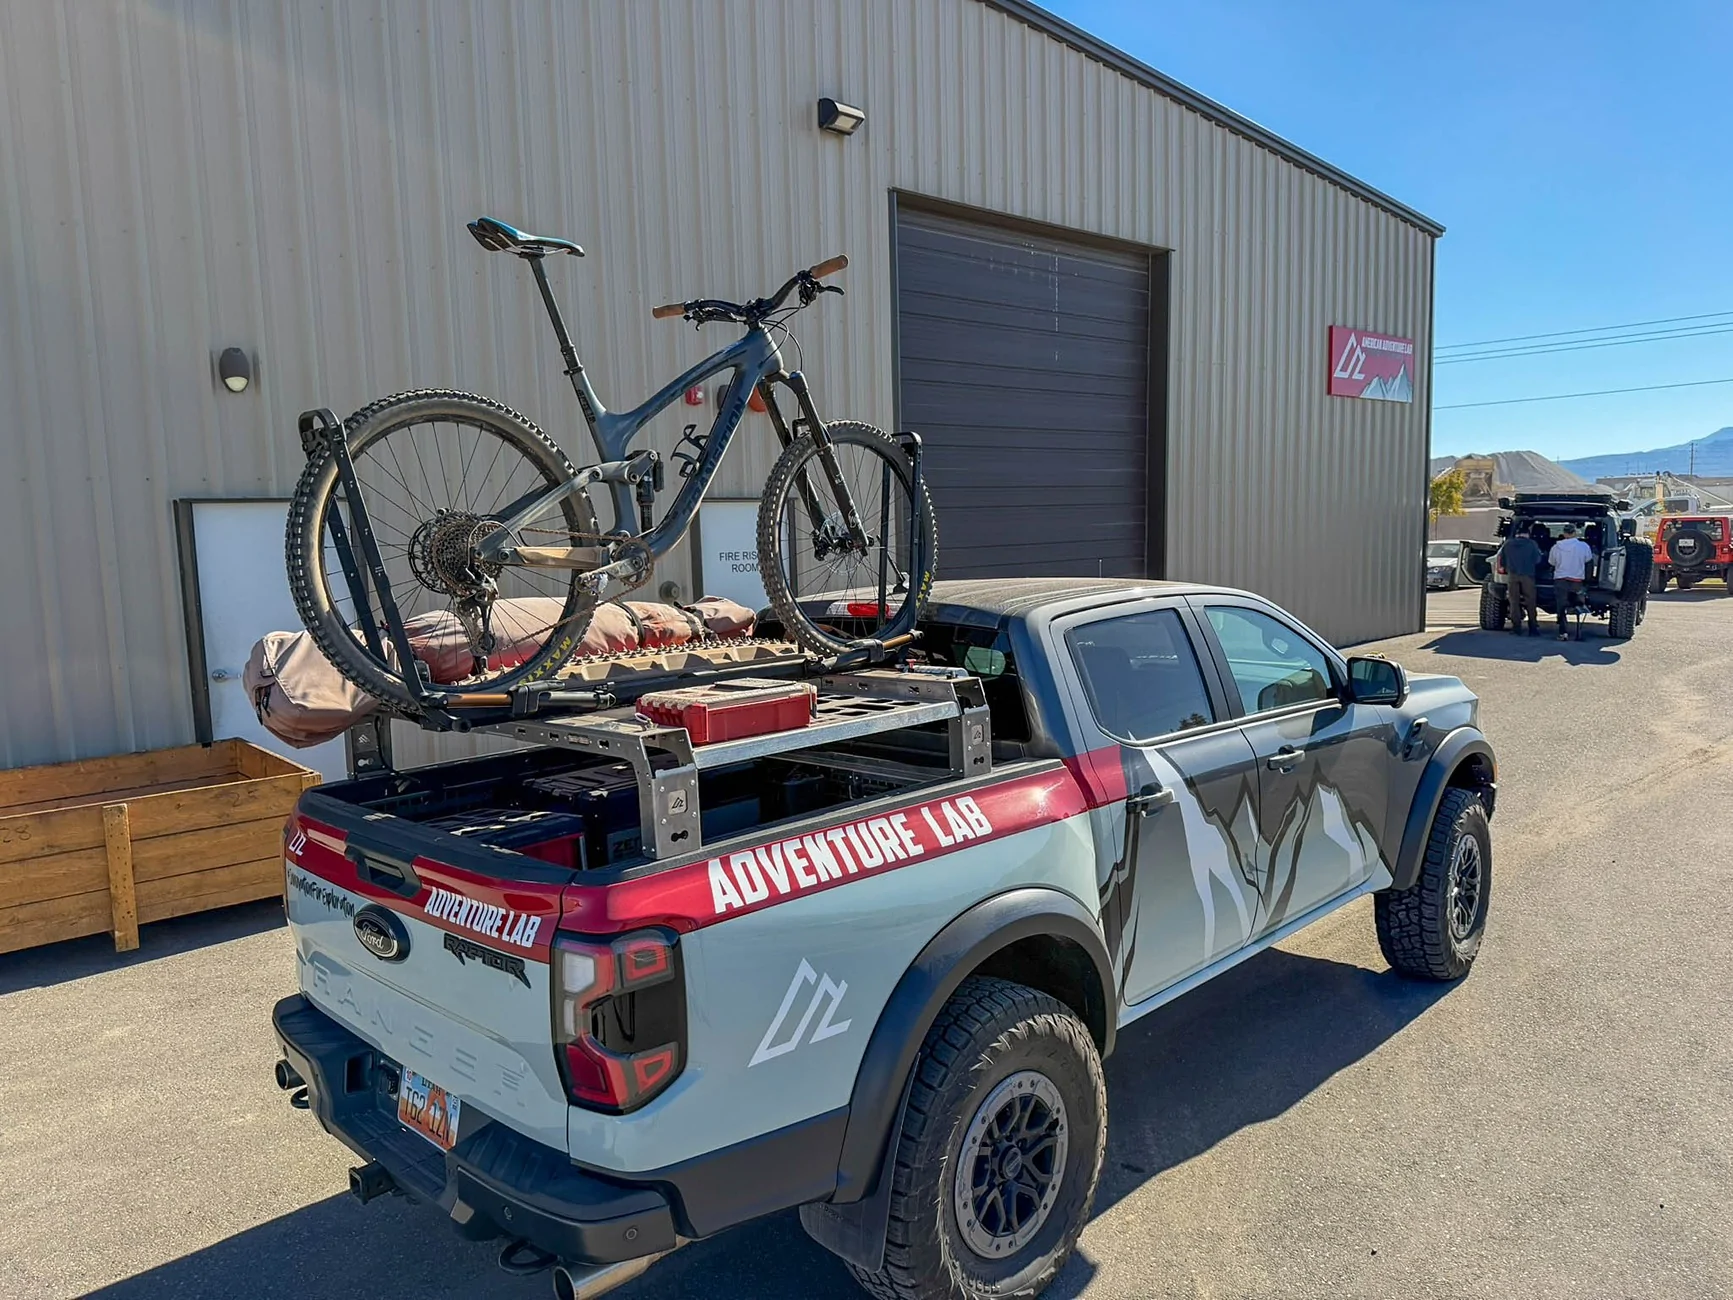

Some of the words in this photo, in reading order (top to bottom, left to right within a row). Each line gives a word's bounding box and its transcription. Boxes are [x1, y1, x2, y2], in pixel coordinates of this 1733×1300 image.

[719, 552, 740, 561] FIRE
[742, 551, 758, 560] RIS
[731, 563, 758, 573] ROOM
[915, 570, 931, 609] MAXX
[707, 812, 925, 915] ADVENTURE
[920, 795, 994, 848] LAB
[361, 921, 385, 950] Ford
[424, 886, 507, 939] ADVENTURE
[501, 910, 542, 948] LAB
[443, 932, 532, 990] RAPTOR
